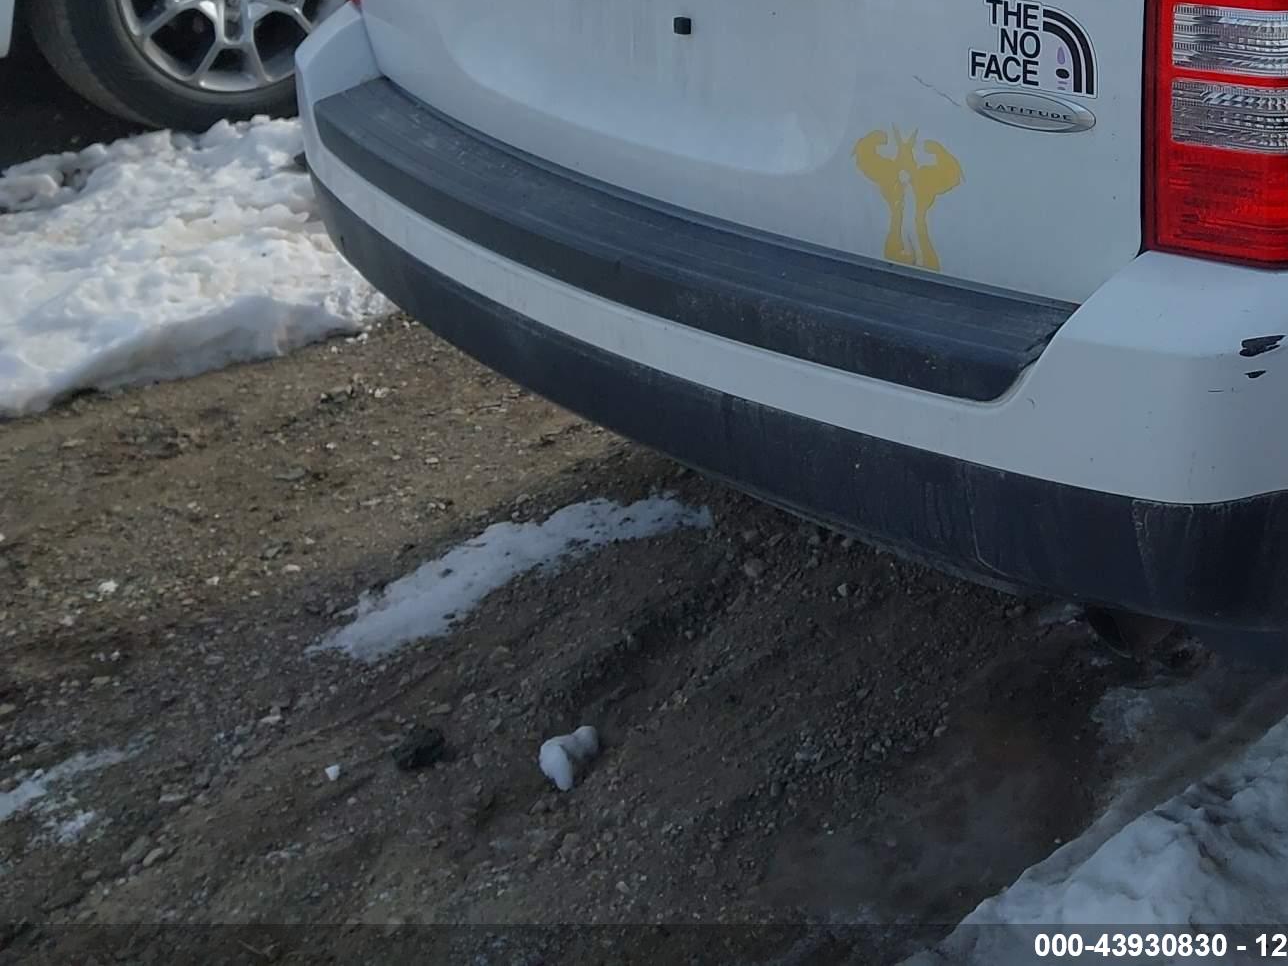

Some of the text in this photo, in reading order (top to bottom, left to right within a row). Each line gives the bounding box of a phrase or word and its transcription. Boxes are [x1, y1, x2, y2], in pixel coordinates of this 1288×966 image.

[1000, 27, 1041, 59] NO
[970, 50, 1040, 87] FACE
[984, 101, 1073, 121] LATITUDE
